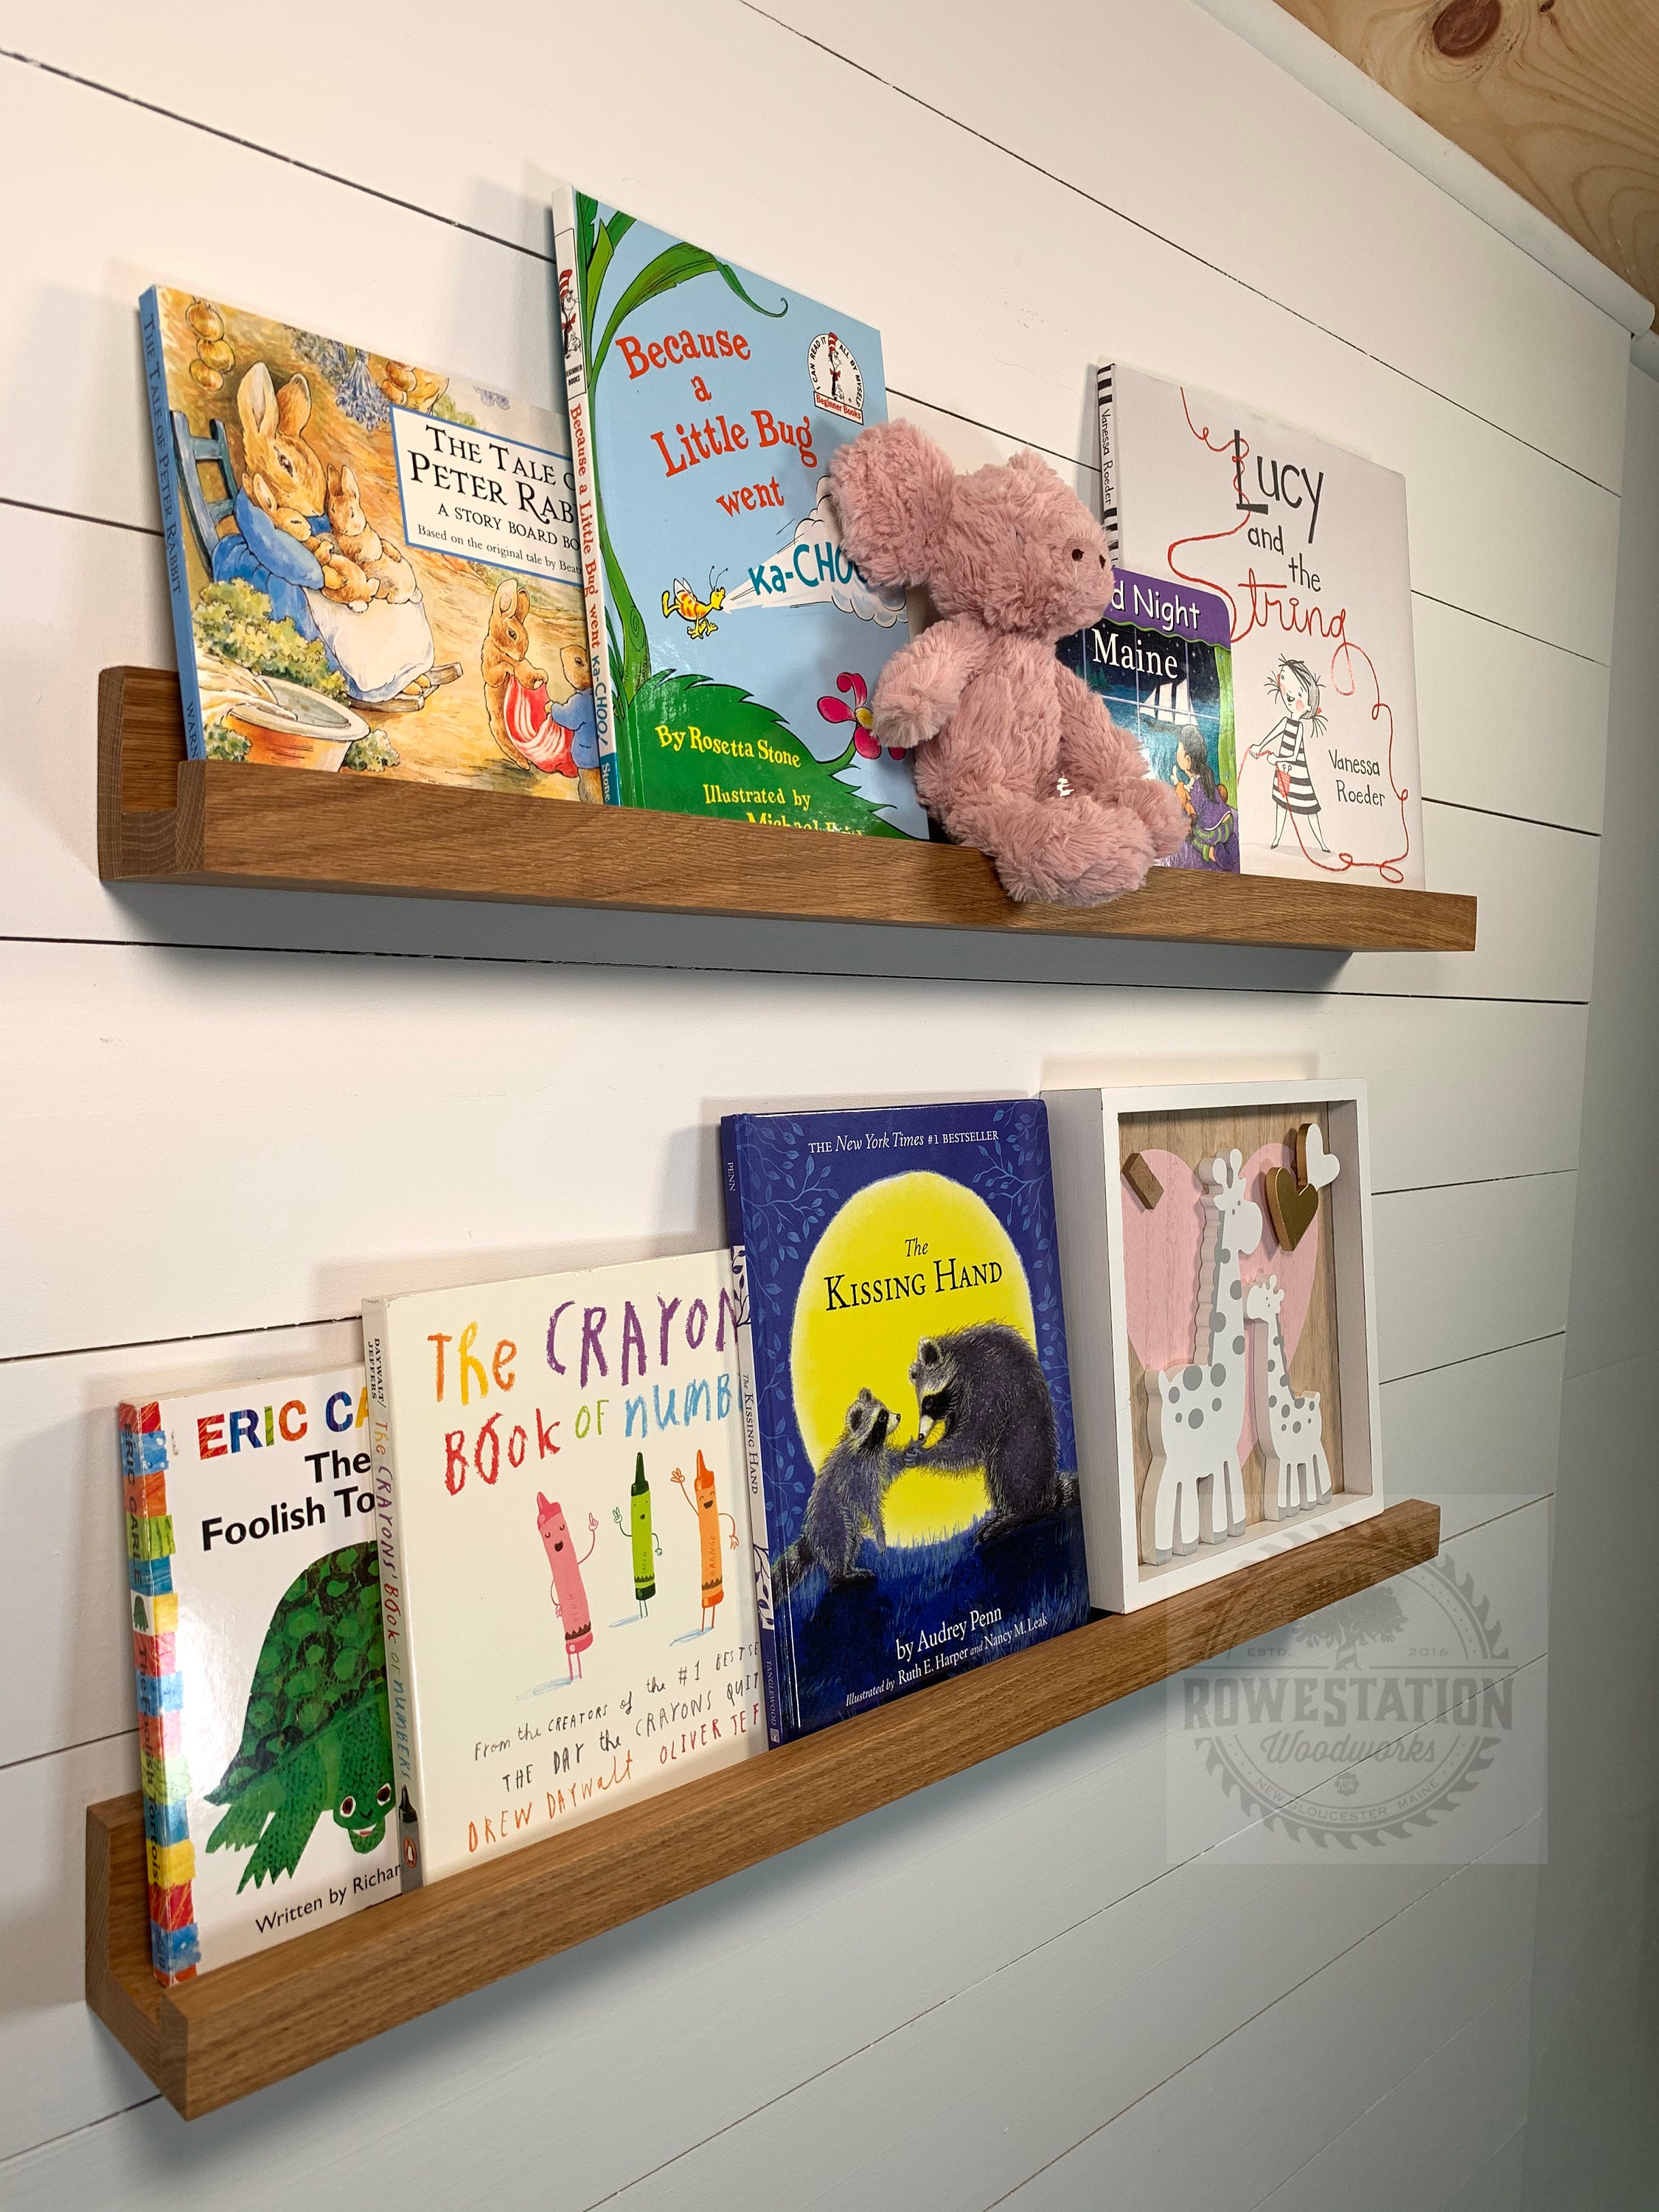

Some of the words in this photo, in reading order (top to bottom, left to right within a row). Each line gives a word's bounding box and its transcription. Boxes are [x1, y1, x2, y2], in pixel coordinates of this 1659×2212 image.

[145, 314, 156, 361] THE
[616, 330, 751, 380] Because
[810, 340, 821, 360] READ
[821, 336, 827, 345] IT
[839, 344, 849, 359] ALL
[810, 363, 818, 383] CAN
[849, 360, 858, 371] BY
[150, 362, 163, 422] TALE
[690, 375, 712, 403] a
[815, 394, 842, 413] Beginner
[844, 405, 861, 420] Books
[855, 375, 863, 408] MYSELF
[156, 426, 166, 451] OF
[426, 425, 482, 464] THE
[490, 443, 556, 485] TALE
[570, 403, 587, 476] Because
[650, 415, 748, 478] Little
[751, 409, 818, 468] Bug
[1101, 408, 1111, 456] Vanessa
[159, 455, 173, 520] PETER
[407, 450, 508, 505] PETER
[515, 480, 579, 524] RAB
[579, 484, 588, 495] a
[716, 476, 785, 517] went
[1103, 459, 1113, 505] Roeder
[417, 524, 447, 541] Based
[451, 534, 464, 546] on
[467, 537, 483, 550] the
[487, 543, 523, 559] original
[526, 550, 542, 564] tale
[545, 554, 557, 570] by
[438, 503, 450, 517] A
[454, 507, 502, 530] STORY
[508, 521, 557, 546] BOARD
[579, 499, 594, 554] Little
[1248, 525, 1284, 556] and
[167, 523, 181, 594] RABBIT
[585, 559, 599, 598] Bug
[748, 541, 869, 596] Ka-CHO
[1288, 552, 1321, 593] the
[589, 603, 601, 649] went
[1133, 584, 1200, 632] Night
[1091, 628, 1178, 679] Maine
[655, 724, 687, 753] By
[689, 726, 755, 758] Rosetta
[757, 740, 802, 768] Stone
[1328, 748, 1380, 776] Vanessa
[601, 762, 611, 803] Stone
[703, 784, 786, 805] Illustrated
[792, 788, 811, 812] by
[1335, 779, 1385, 807] Roeder
[808, 1142, 832, 1153] THE
[835, 1135, 862, 1152] New
[866, 1133, 890, 1149] York
[892, 1131, 924, 1147] Times
[928, 1134, 939, 1144] #1
[942, 1130, 998, 1144] BESTSELLER
[727, 1162, 736, 1192] PENN
[905, 1237, 928, 1257] The
[824, 1273, 926, 1311] KISSING
[933, 1258, 1003, 1293] HAND
[368, 1340, 377, 1399] JEFFERS
[427, 1321, 518, 1406] The
[197, 1399, 308, 1460] ERIC
[373, 1420, 389, 1455] The
[574, 1399, 609, 1439] OF
[124, 1423, 136, 1486] ERIC
[304, 1449, 372, 1483] The
[129, 1501, 142, 1585] CARLE
[202, 1496, 326, 1551] Foolish
[896, 1638, 914, 1663] by
[917, 1621, 967, 1652] Audrey
[970, 1607, 1002, 1632] Penn
[846, 1683, 885, 1707] Illustrated
[886, 1678, 895, 1691] by
[897, 1663, 922, 1686] Ruth
[924, 1659, 934, 1675] E.
[935, 1647, 969, 1672] Harper
[970, 1641, 983, 1656] and
[984, 1629, 1012, 1650] Nancy
[1015, 1624, 1027, 1638] M.
[1028, 1612, 1048, 1632] Leak
[475, 1738, 511, 1761] From
[518, 1722, 541, 1742] the
[548, 1703, 608, 1733] CREATORS
[619, 1691, 633, 1715] of
[646, 1676, 667, 1694] the
[678, 1660, 700, 1686] #1
[767, 1660, 776, 1725] TANGLEWOOD
[502, 1764, 534, 1792] THE
[553, 1742, 584, 1775] DAY
[599, 1731, 622, 1753] the
[636, 1689, 712, 1738] CRAYONS
[726, 1672, 759, 1704] QUIT
[468, 1801, 533, 1853] DREW
[659, 1718, 722, 1765] OLIVER
[255, 1898, 323, 1934] Written
[329, 1887, 347, 1906] by
